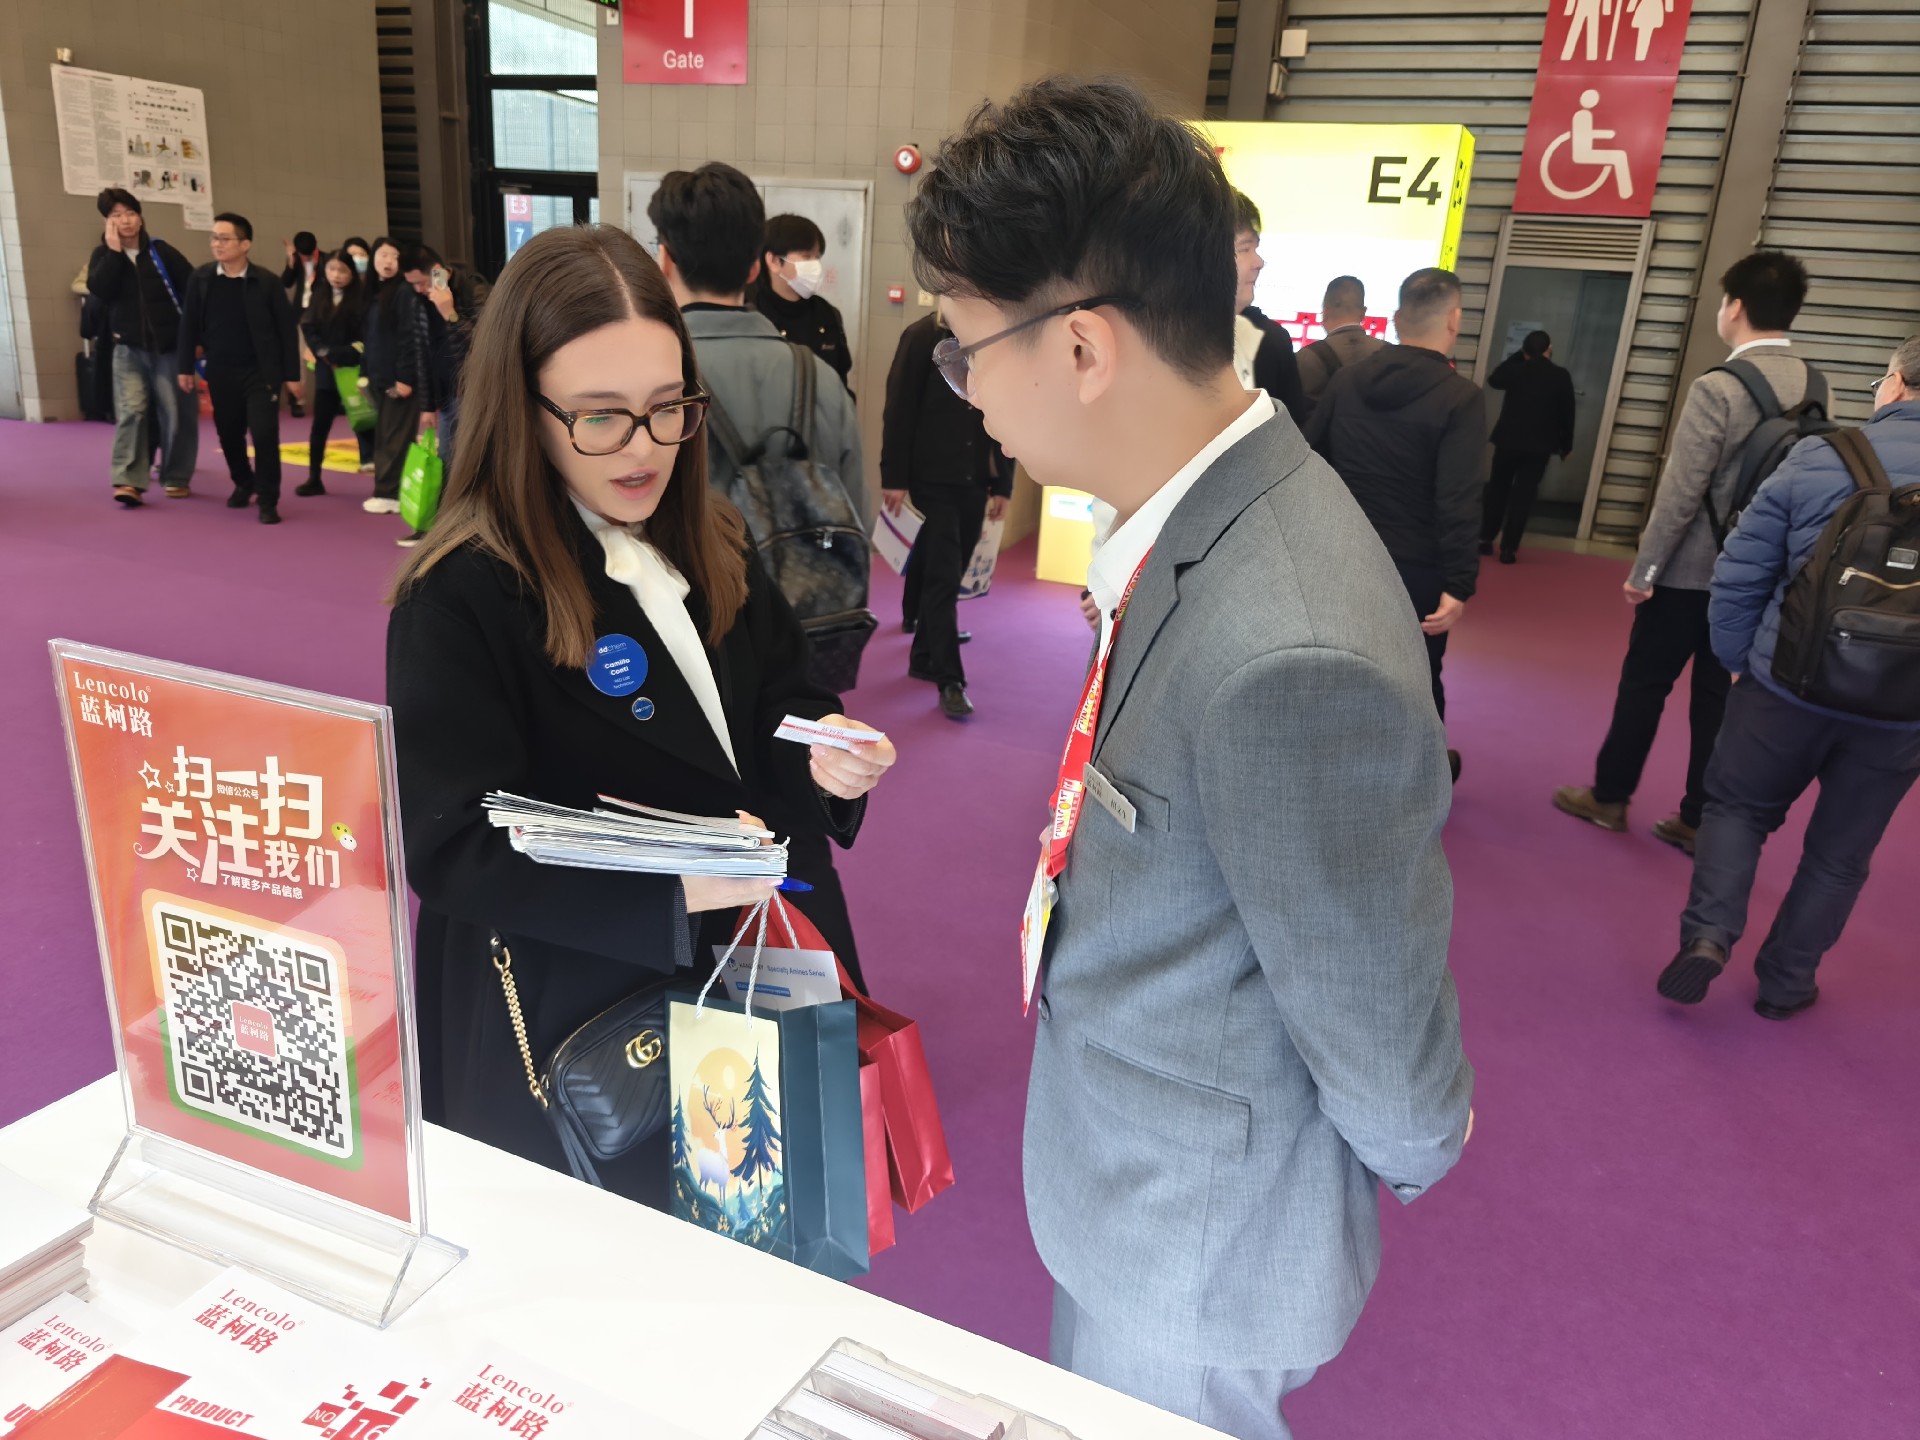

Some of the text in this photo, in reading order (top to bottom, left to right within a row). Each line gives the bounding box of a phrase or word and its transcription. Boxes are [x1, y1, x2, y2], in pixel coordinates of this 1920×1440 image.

[663, 50, 704, 69] Gate
[1368, 156, 1442, 206] E4
[511, 195, 529, 214] E3
[610, 666, 629, 676] Conti
[79, 694, 153, 738] 蓝柯路
[172, 745, 323, 840] 扫一扫
[216, 784, 260, 800] 微信公众号
[133, 796, 341, 889] 关注我们
[220, 873, 304, 900] 了解更多产品信息
[767, 965, 789, 975] Specialty
[809, 969, 826, 977] Series
[192, 1303, 279, 1354] 蓝柯路
[16, 1327, 88, 1373] 蓝柯路
[167, 1394, 255, 1428] PRODUCT
[452, 1381, 550, 1440] 蓝柯路
[349, 1418, 391, 1440] 16
